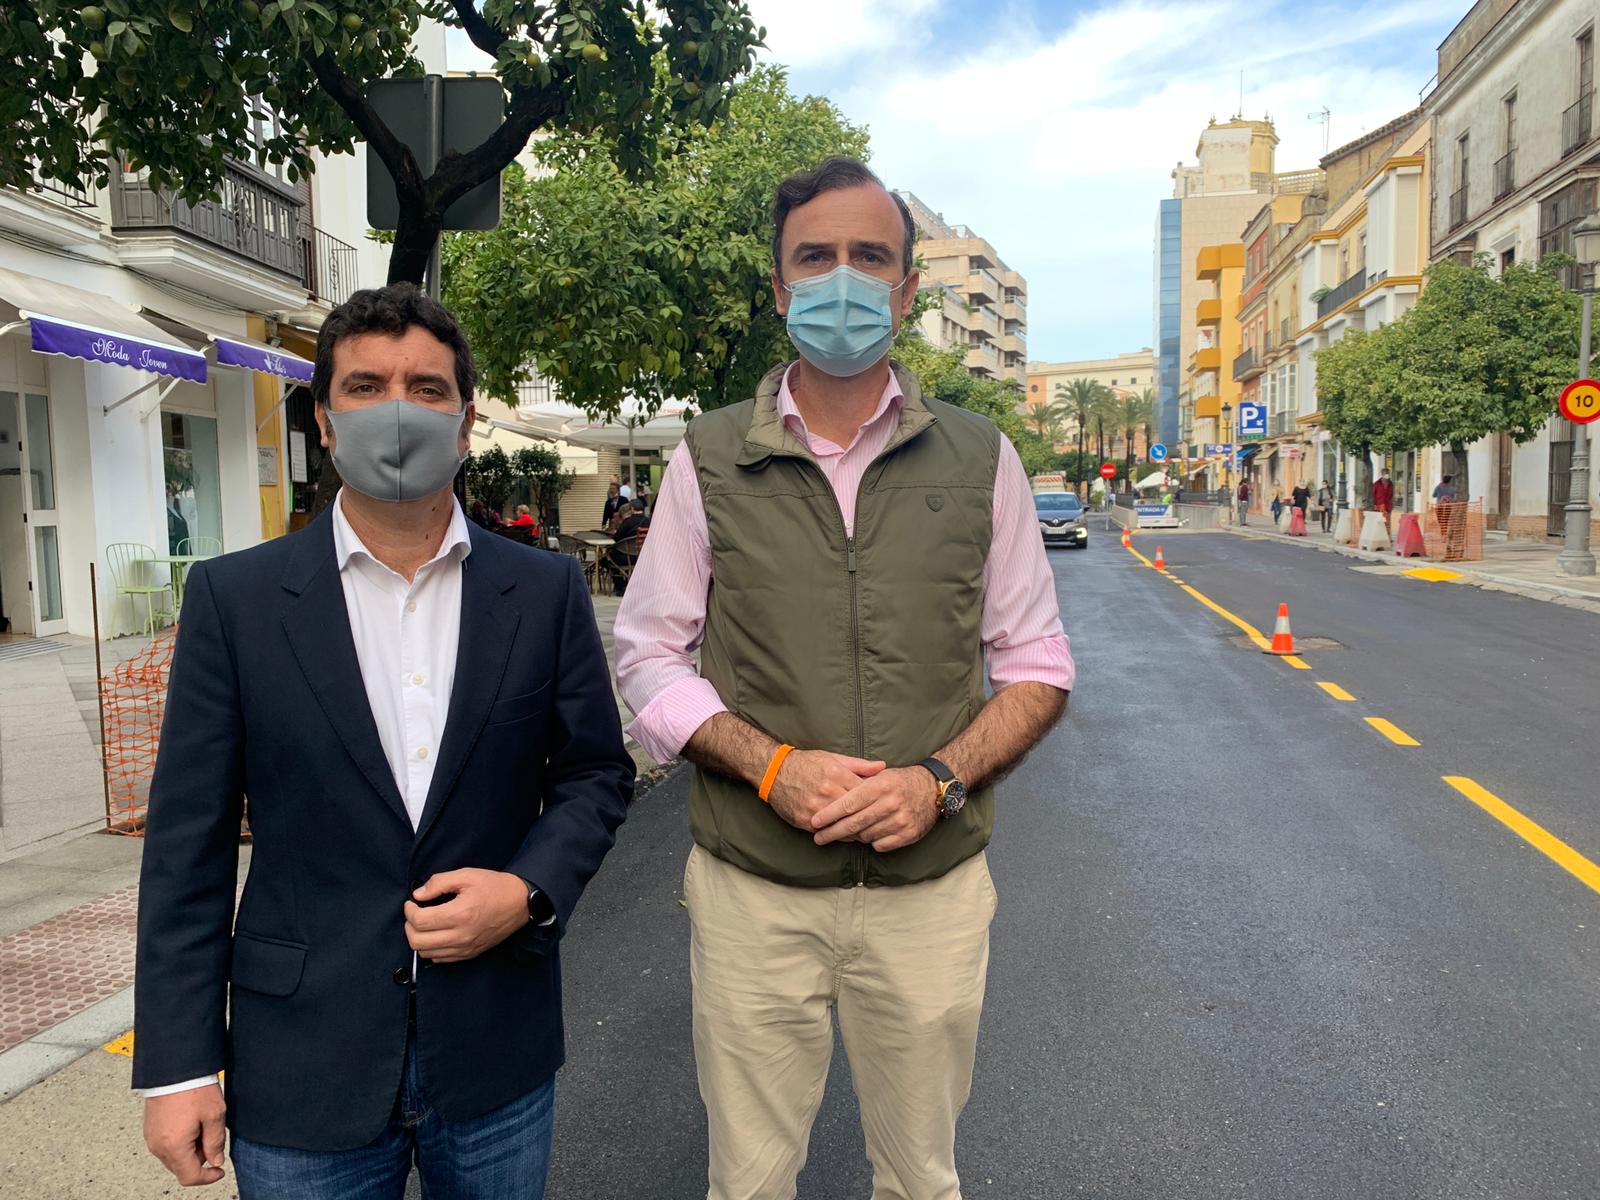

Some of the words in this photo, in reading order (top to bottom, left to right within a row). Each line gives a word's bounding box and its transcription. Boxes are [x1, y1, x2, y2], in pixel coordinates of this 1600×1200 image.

[92, 338, 129, 361] Moda
[139, 350, 167, 370] Joven
[1575, 394, 1594, 408] 10
[1242, 407, 1258, 428] P
